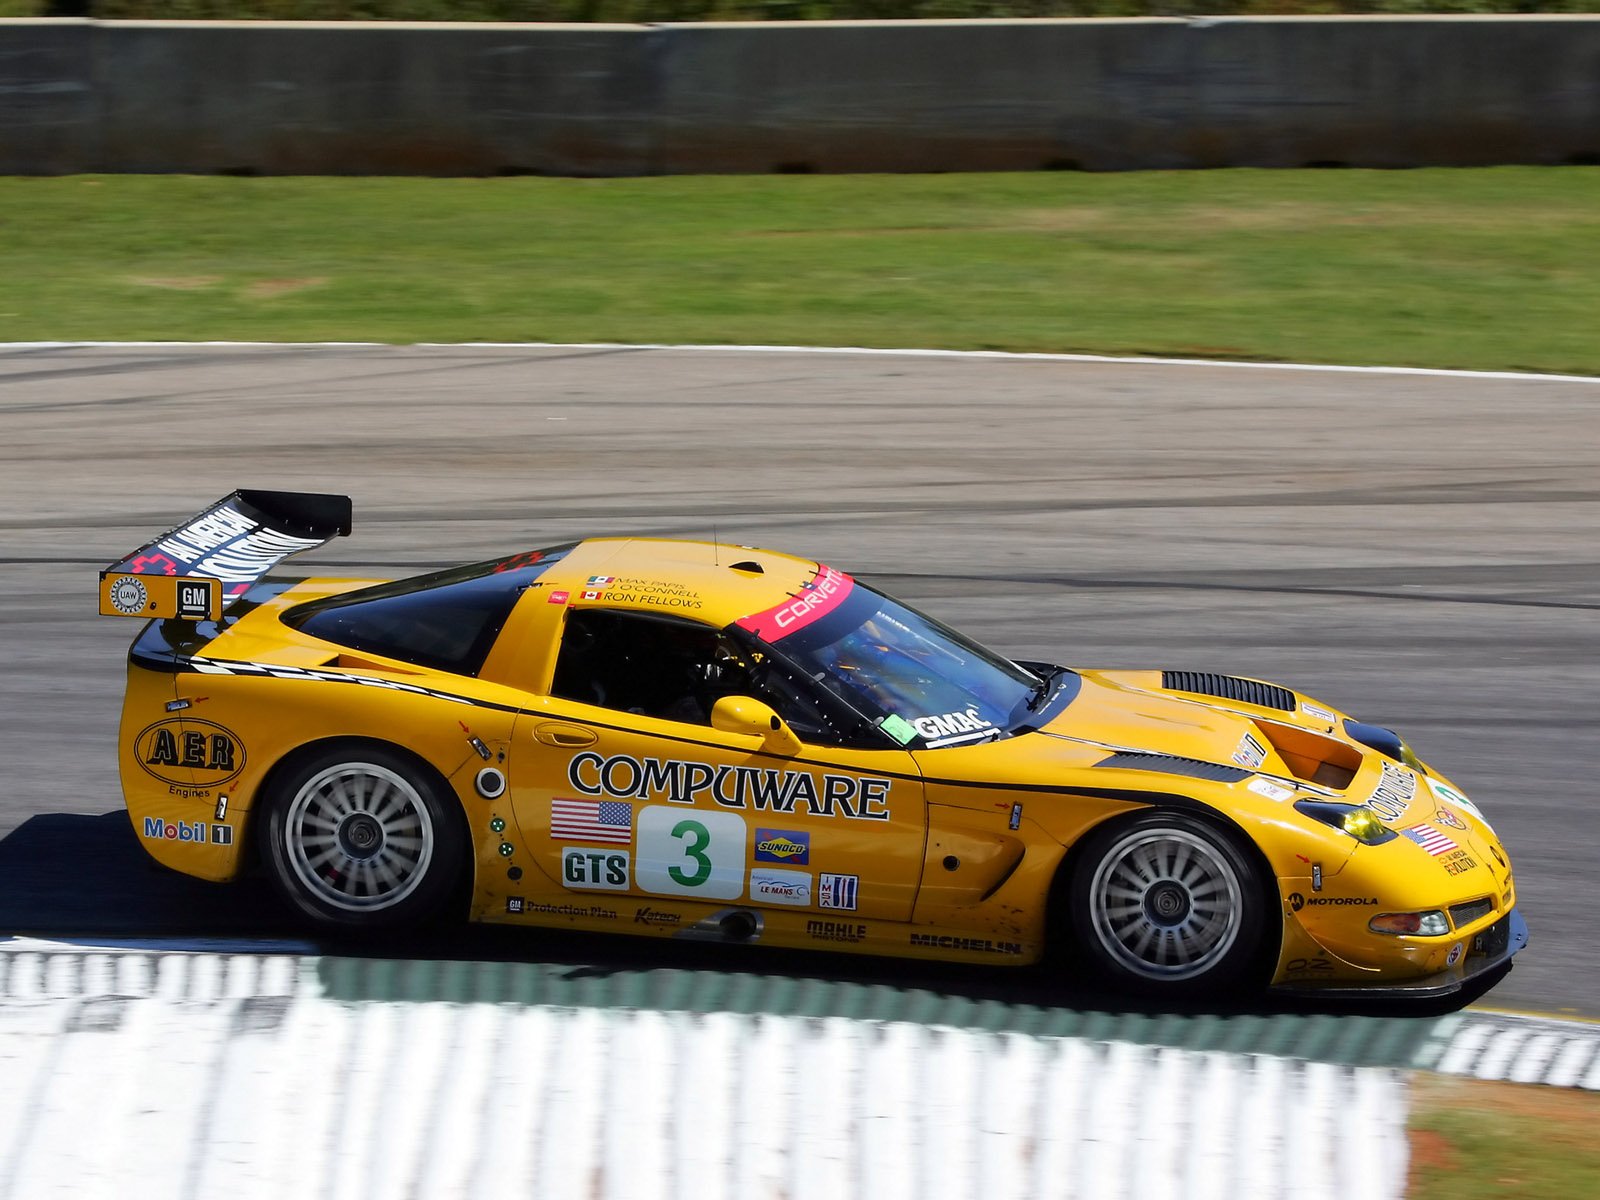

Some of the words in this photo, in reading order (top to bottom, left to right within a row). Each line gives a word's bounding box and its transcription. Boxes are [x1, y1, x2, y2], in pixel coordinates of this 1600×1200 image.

[158, 538, 205, 564] AN
[186, 527, 325, 604] VOLUTION
[120, 591, 137, 600] UAW
[182, 587, 206, 606] GM
[604, 592, 636, 602] RON
[640, 595, 703, 609] FELLOWS
[775, 567, 843, 628] CORVETT
[914, 708, 992, 739] GMAC
[147, 729, 235, 772] AER
[168, 785, 210, 799] Engines
[569, 750, 892, 821] COMPUWARE
[144, 816, 206, 843] Mobil
[667, 819, 713, 887] 3
[758, 841, 806, 855] SUNOCO
[563, 852, 627, 886] GTS
[771, 887, 793, 896] MANS
[821, 876, 832, 906] IMSA
[1307, 897, 1379, 906] MOTOROLA
[509, 900, 521, 909] GM
[527, 901, 588, 917] Protection
[590, 906, 617, 920] Plan
[806, 920, 867, 939] MAHLE
[910, 933, 1022, 954] MICHELIN
